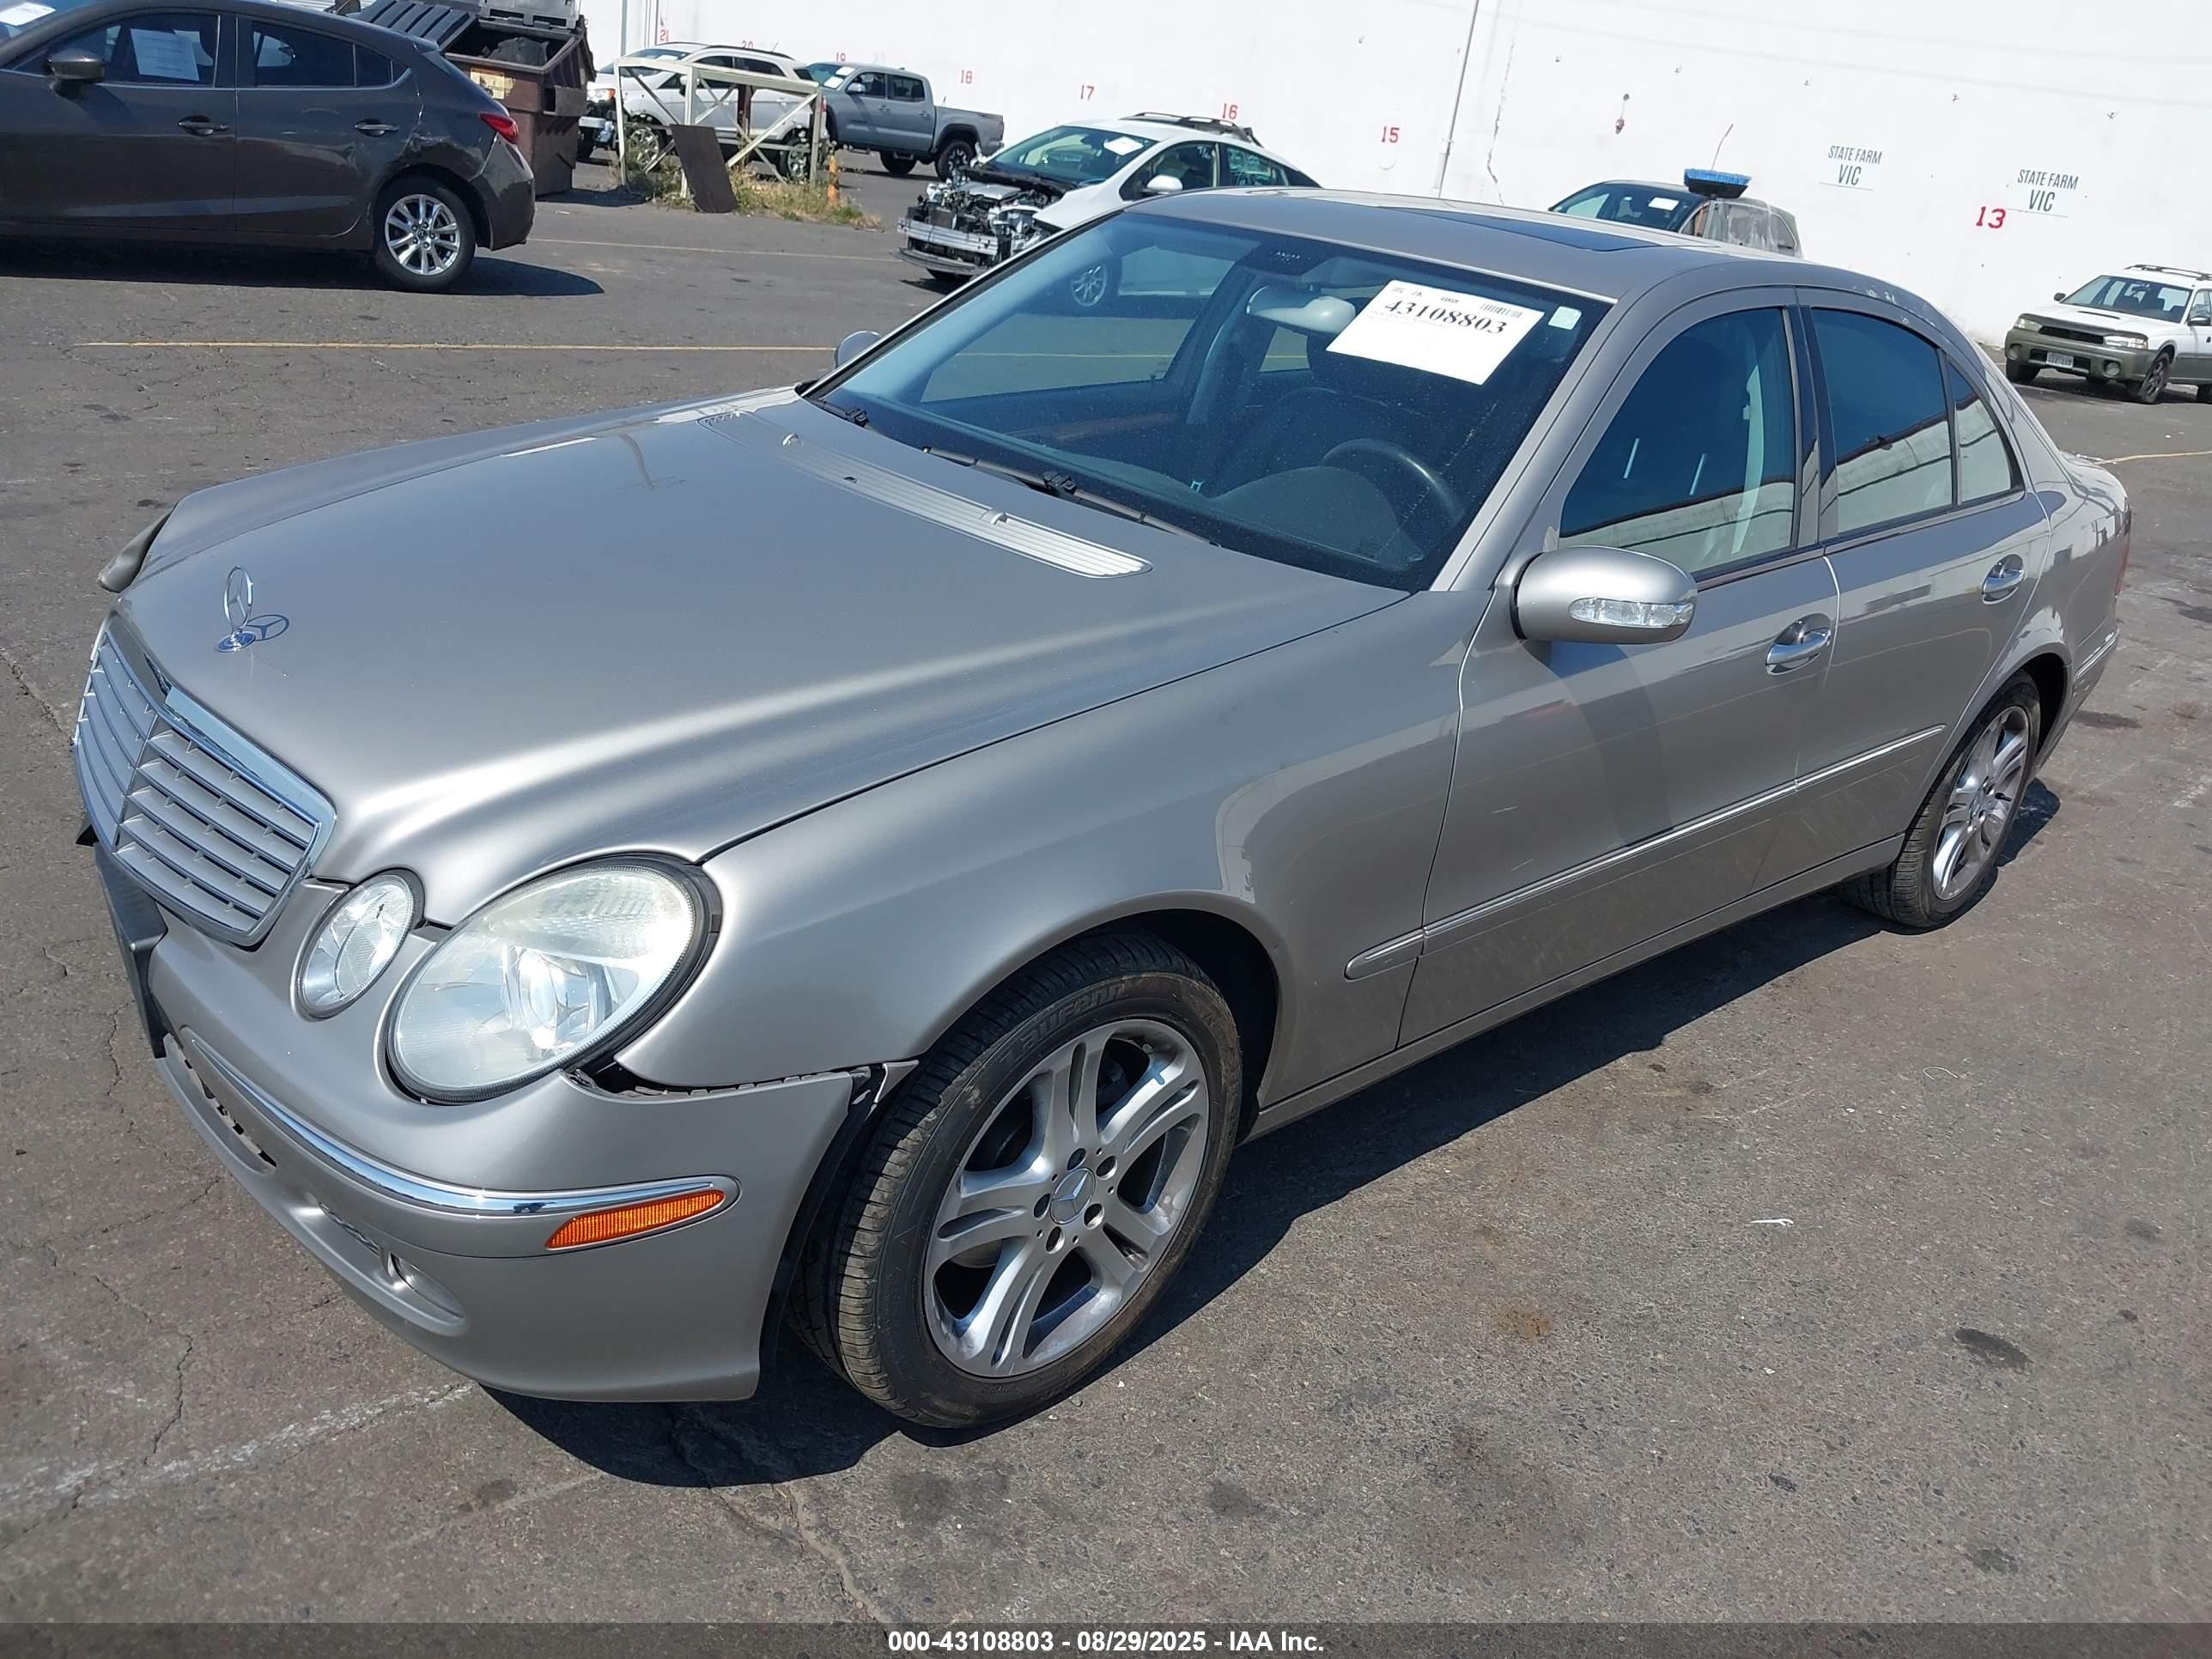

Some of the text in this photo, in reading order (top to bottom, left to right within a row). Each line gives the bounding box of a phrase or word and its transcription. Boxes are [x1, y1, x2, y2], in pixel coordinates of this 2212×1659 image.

[659, 29, 669, 42] 21
[960, 70, 972, 84] 18
[1079, 84, 1095, 100] 17
[1222, 103, 1238, 119] 16
[1381, 125, 1401, 143] 15
[1828, 145, 1882, 165] STATE FARM
[1838, 164, 1862, 185] VIC
[2017, 169, 2079, 190] STATE FARM
[2028, 189, 2056, 212] VIC
[1976, 206, 2006, 228] 13
[1384, 300, 1507, 334] 43108803
